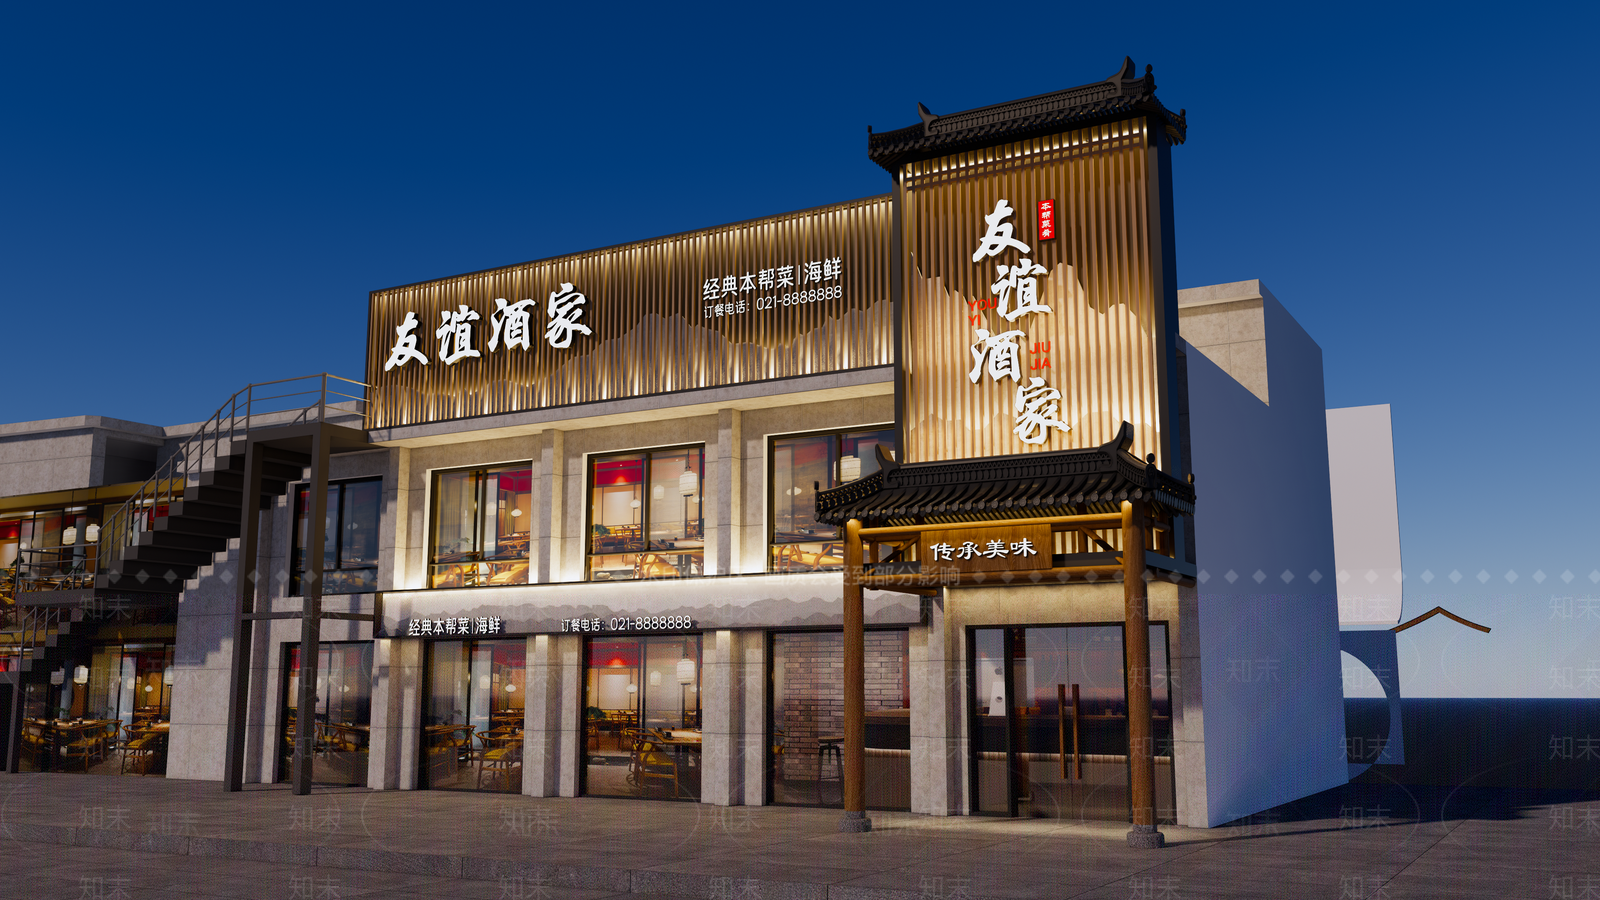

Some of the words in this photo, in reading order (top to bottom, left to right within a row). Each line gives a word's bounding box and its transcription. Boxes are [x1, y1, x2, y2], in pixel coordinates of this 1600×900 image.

[756, 285, 843, 311] 021-8888888
[967, 297, 998, 312] YOU
[383, 282, 593, 372] 友谊酒家
[968, 314, 981, 327] YI
[969, 198, 1072, 445] 友谊酒家
[1029, 341, 1051, 355] JIU
[1029, 358, 1052, 371] JIA
[929, 537, 1037, 562] 传承美味
[610, 614, 692, 631] 021-8888888
